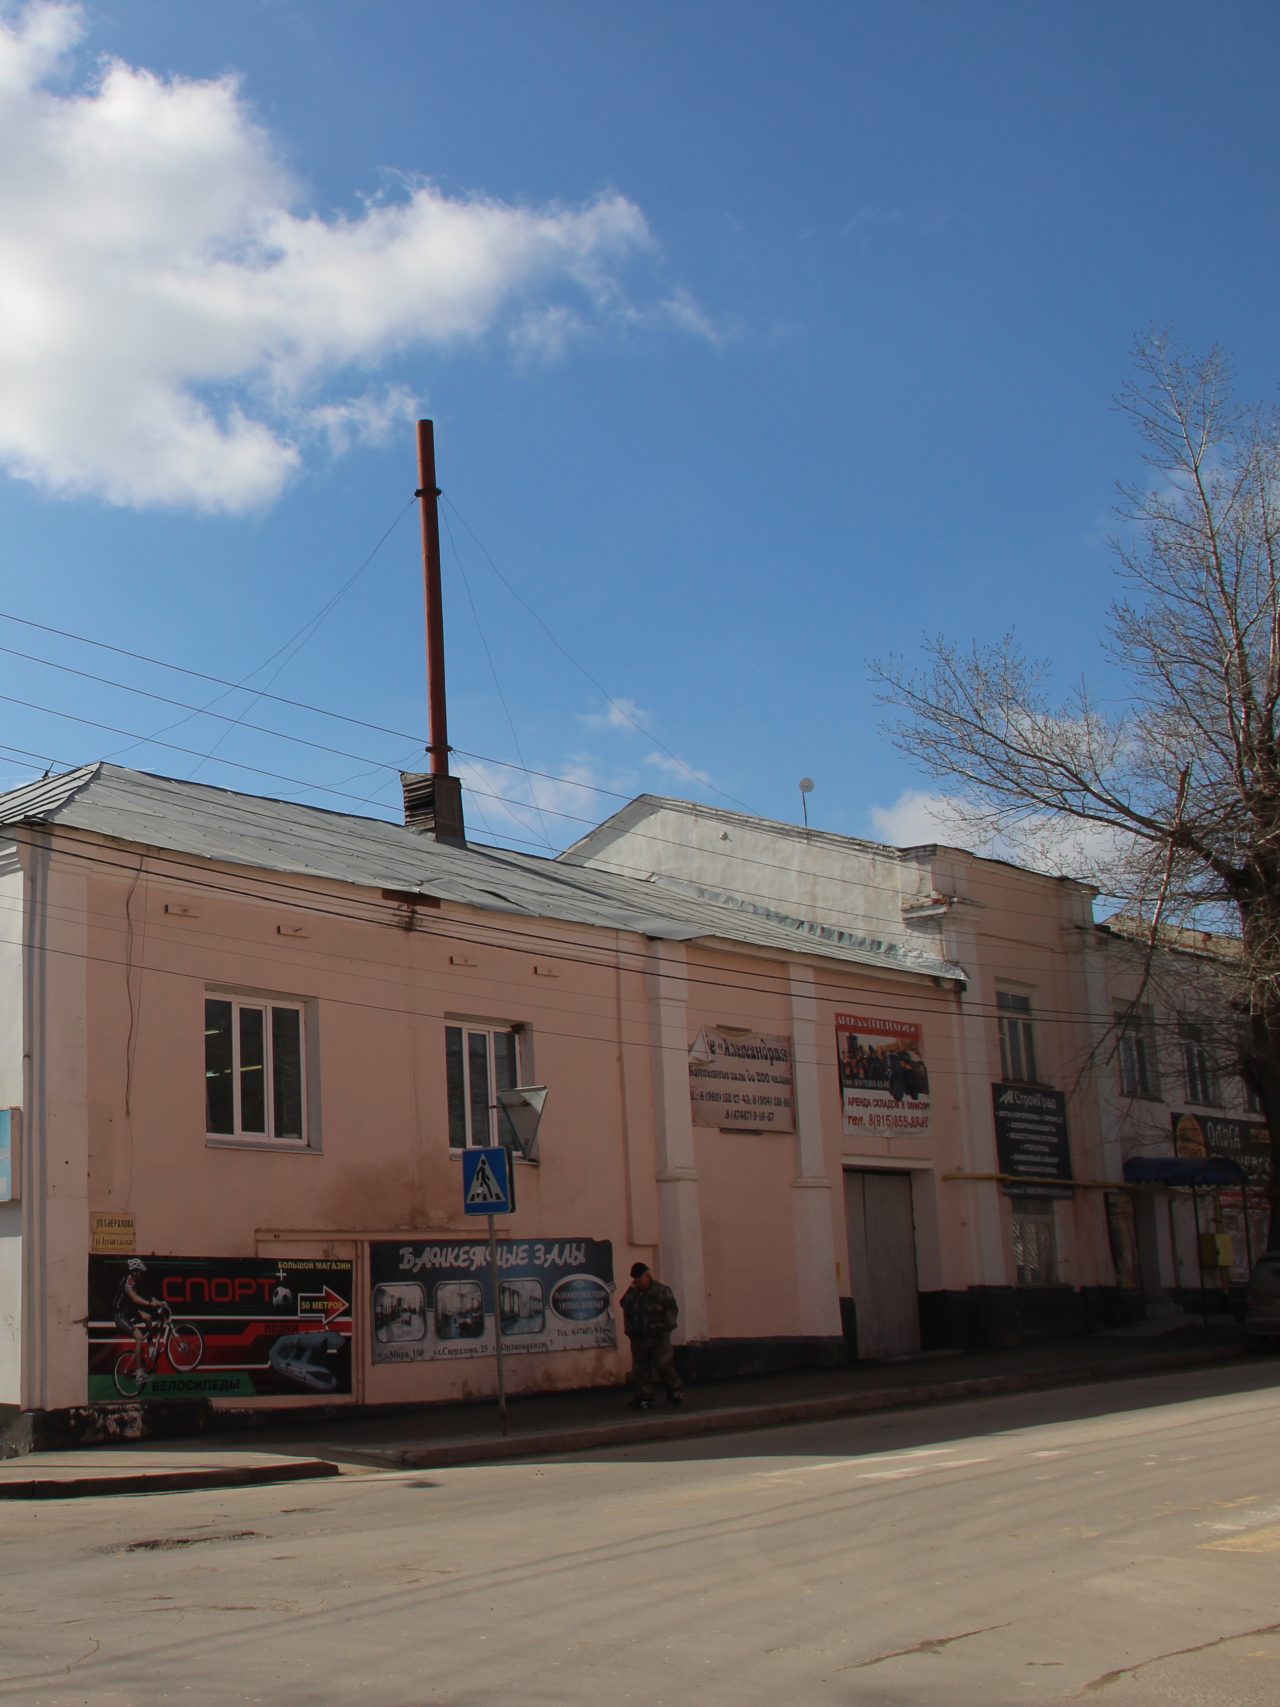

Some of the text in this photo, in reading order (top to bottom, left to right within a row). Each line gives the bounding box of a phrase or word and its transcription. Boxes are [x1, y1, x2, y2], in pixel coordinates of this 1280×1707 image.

[848, 1097, 871, 1108] АРЕНДА
[872, 1098, 899, 1110] СКЛАДОВ
[848, 1115, 865, 1127] тел.
[277, 1261, 352, 1270] БОЛЬШОЙ МАГАЗИН
[161, 1276, 277, 1305] СПОРТ
[301, 1301, 344, 1310] 50 МЕТРОВ
[263, 1323, 298, 1336] ЛОДКИ
[150, 1378, 241, 1393] ВЕЛОСИПЕДЫ
